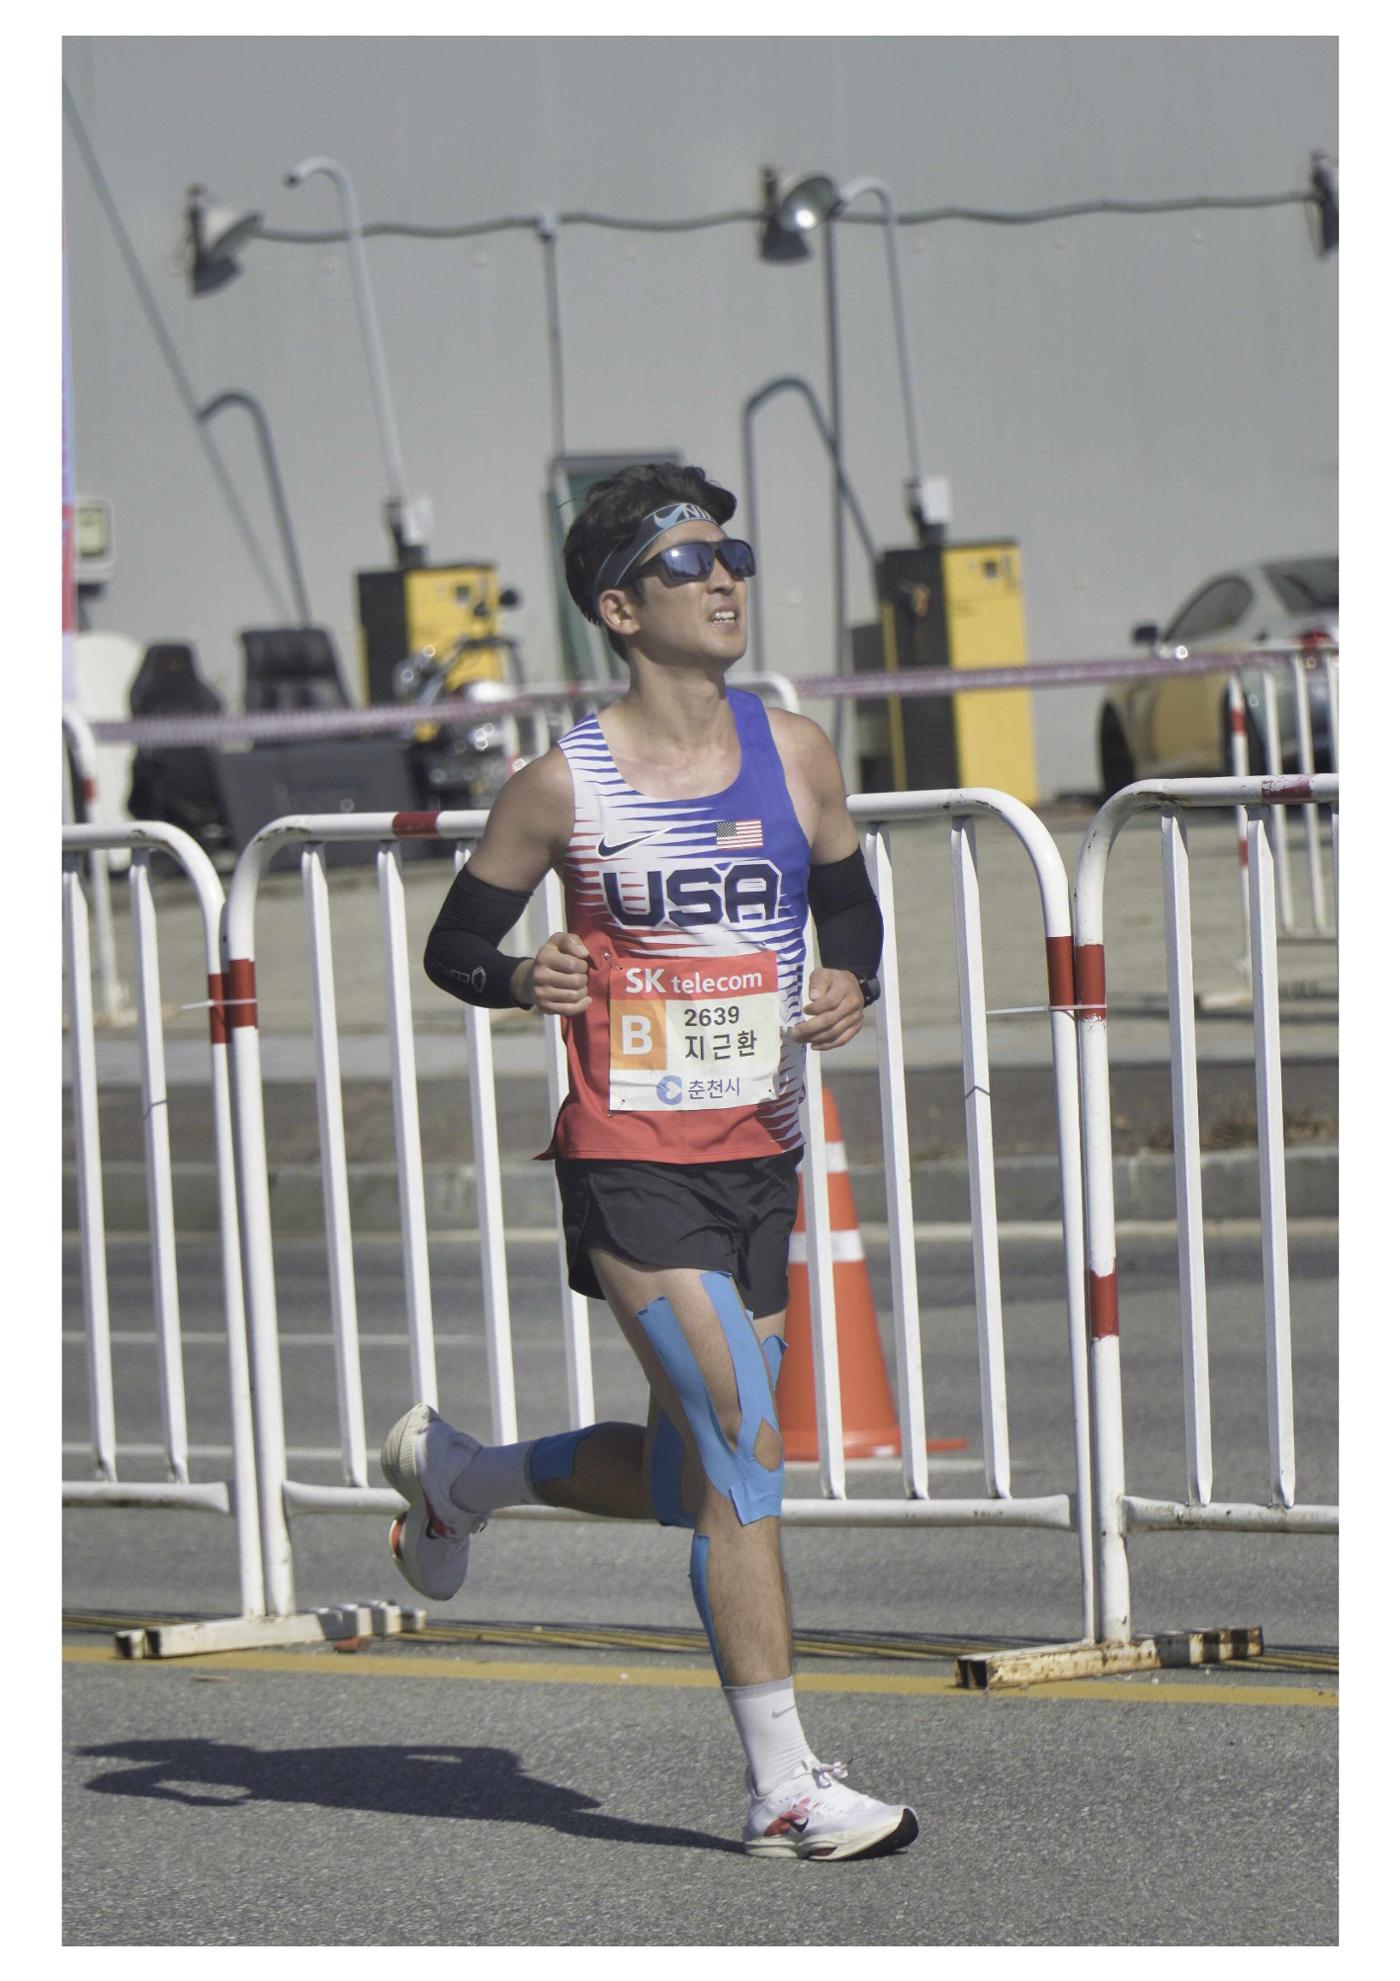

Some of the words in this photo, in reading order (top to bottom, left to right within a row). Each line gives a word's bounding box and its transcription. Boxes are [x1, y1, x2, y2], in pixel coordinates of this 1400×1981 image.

[602, 861, 781, 928] USA
[625, 967, 667, 993] SK
[671, 969, 762, 994] telecom
[684, 1005, 740, 1027] 2639
[621, 1015, 653, 1056] B
[684, 1030, 757, 1061] 지근환
[688, 1078, 740, 1100] 춘천시
